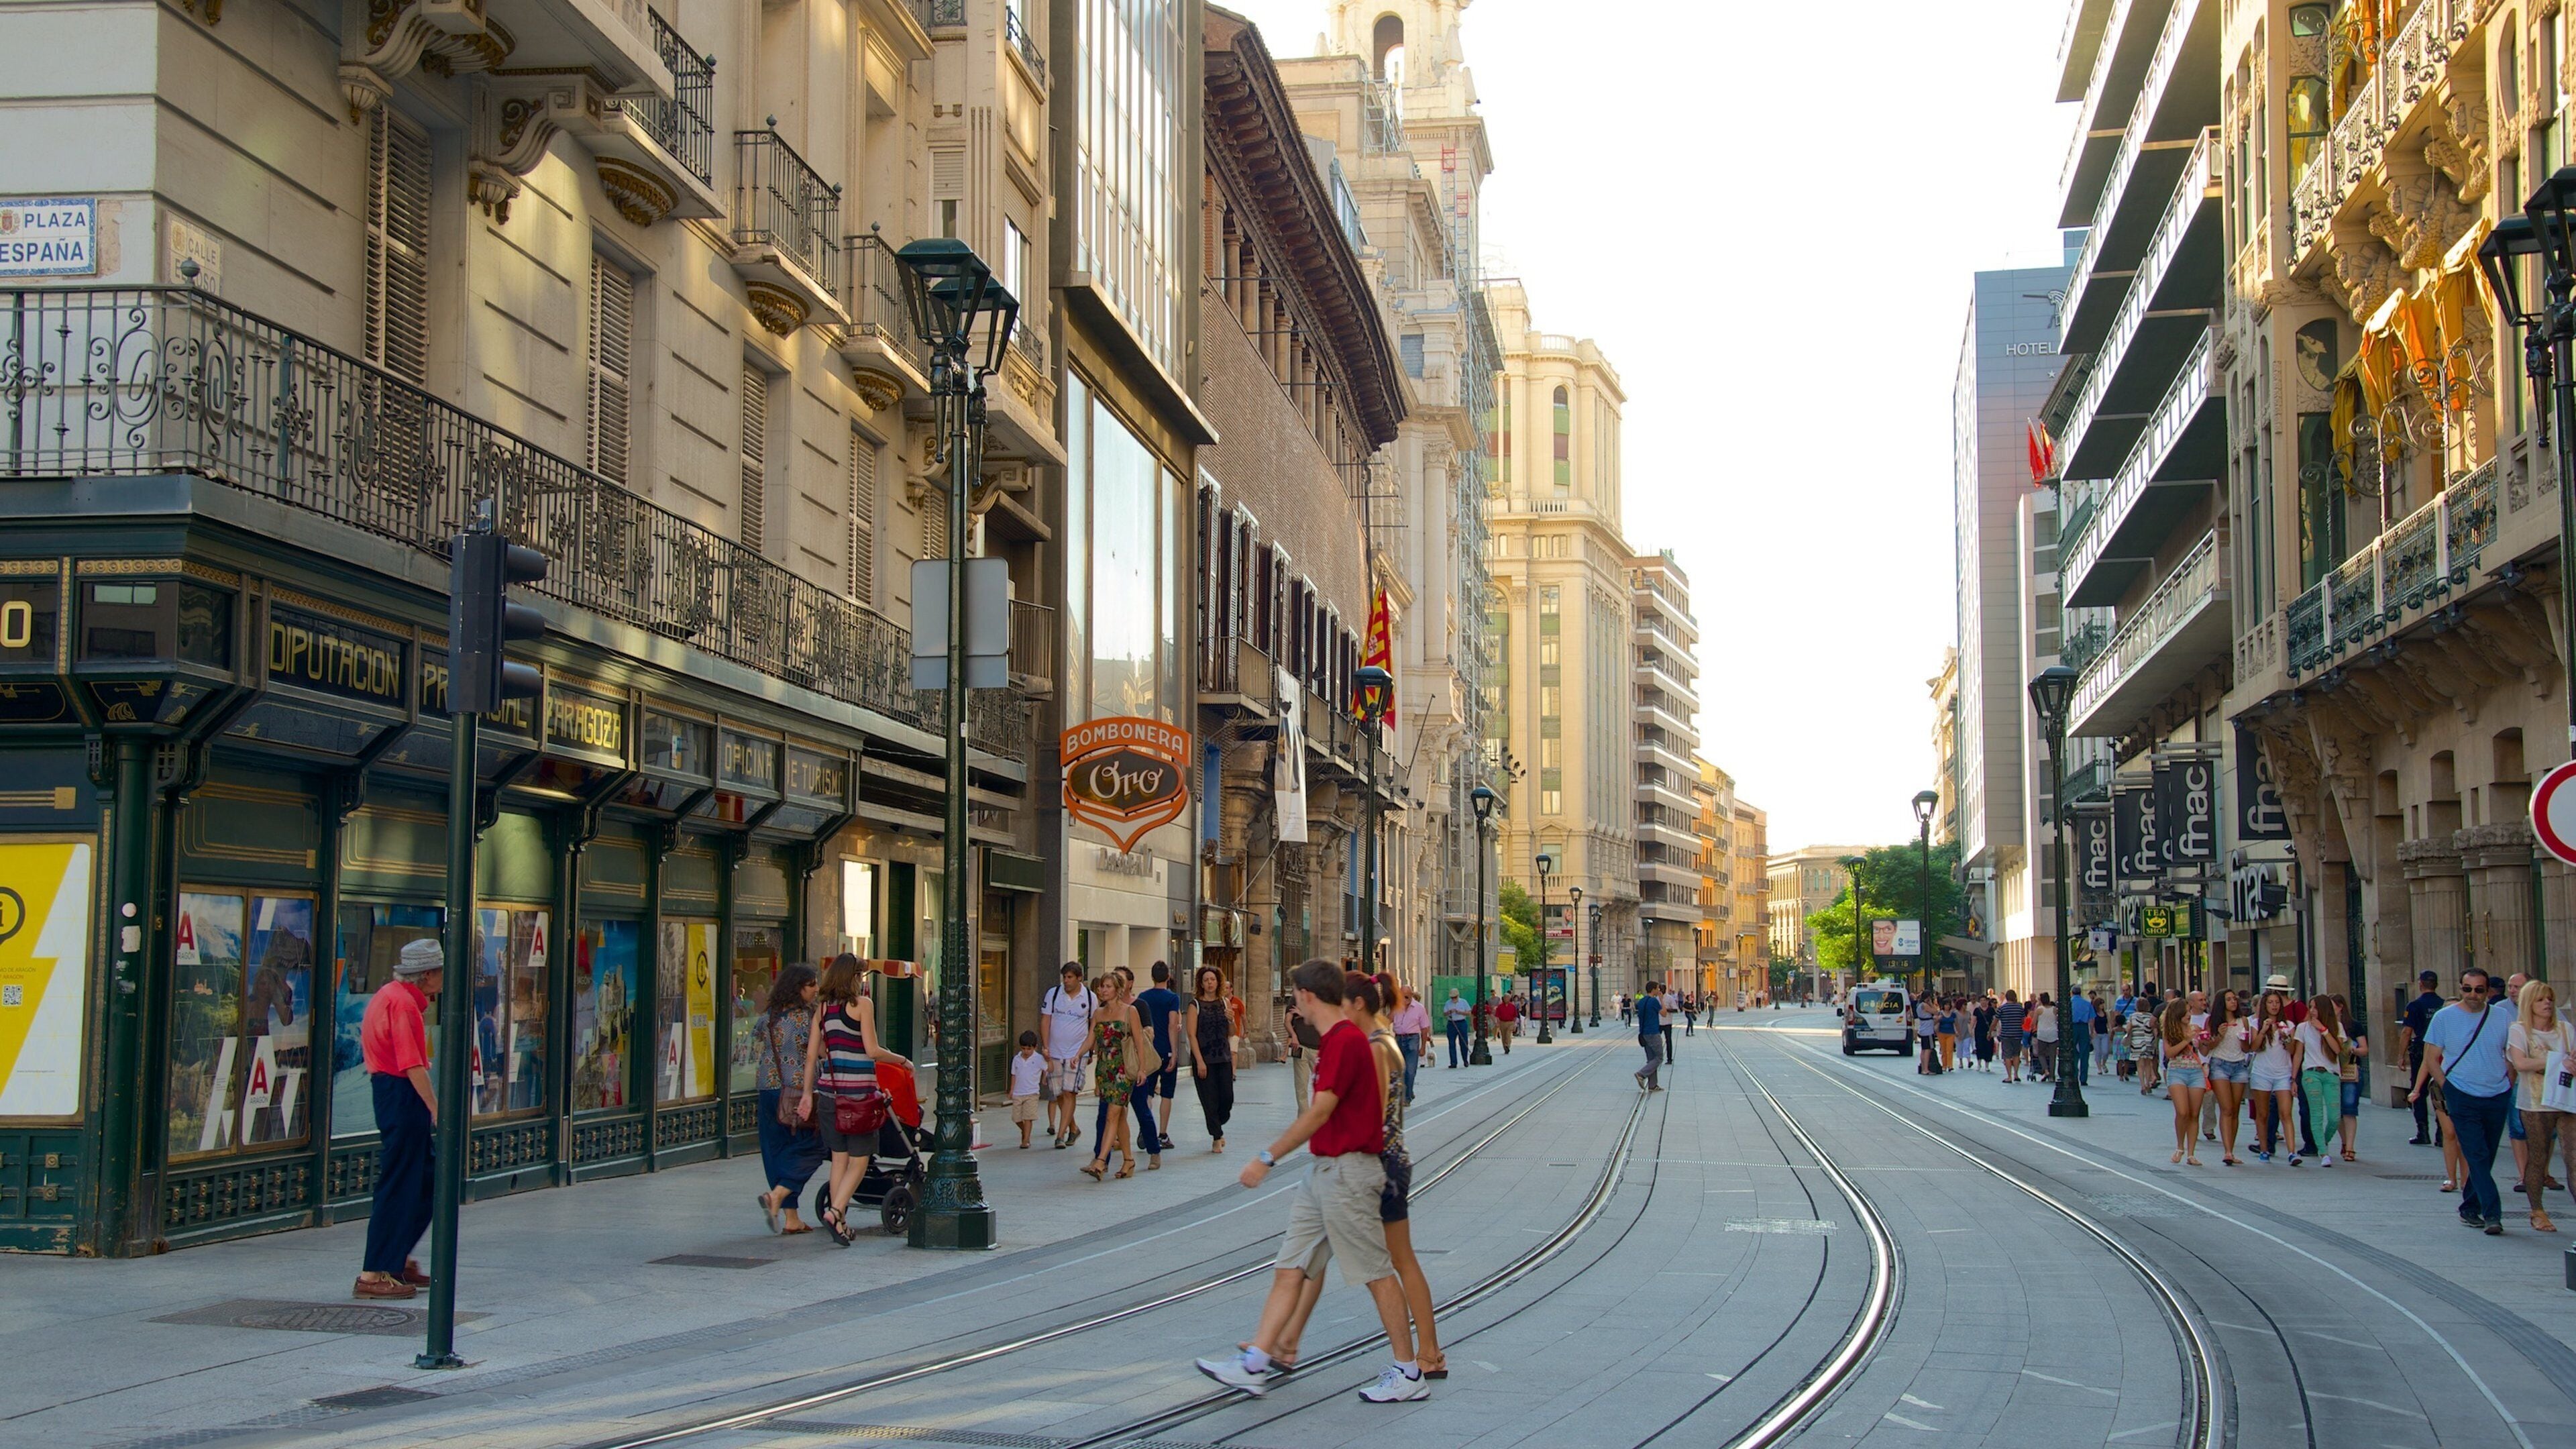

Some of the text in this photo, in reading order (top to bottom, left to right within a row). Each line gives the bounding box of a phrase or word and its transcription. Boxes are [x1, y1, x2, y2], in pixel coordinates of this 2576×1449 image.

[24, 211, 86, 228] PLAZA
[0, 237, 84, 263] ESPAÑA
[188, 238, 216, 266] CALLE
[2006, 341, 2057, 357] HOTEL
[270, 621, 400, 699] DIPUTACION
[547, 696, 621, 751] ZARAGOZA
[1067, 723, 1183, 755] BOMBONERA
[724, 742, 773, 780] OFICINA
[802, 763, 844, 797] TURISMO
[1089, 761, 1164, 799] Oro
[2179, 765, 2210, 858] fnac
[2133, 792, 2161, 873] fnac
[2084, 820, 2108, 889] fnac
